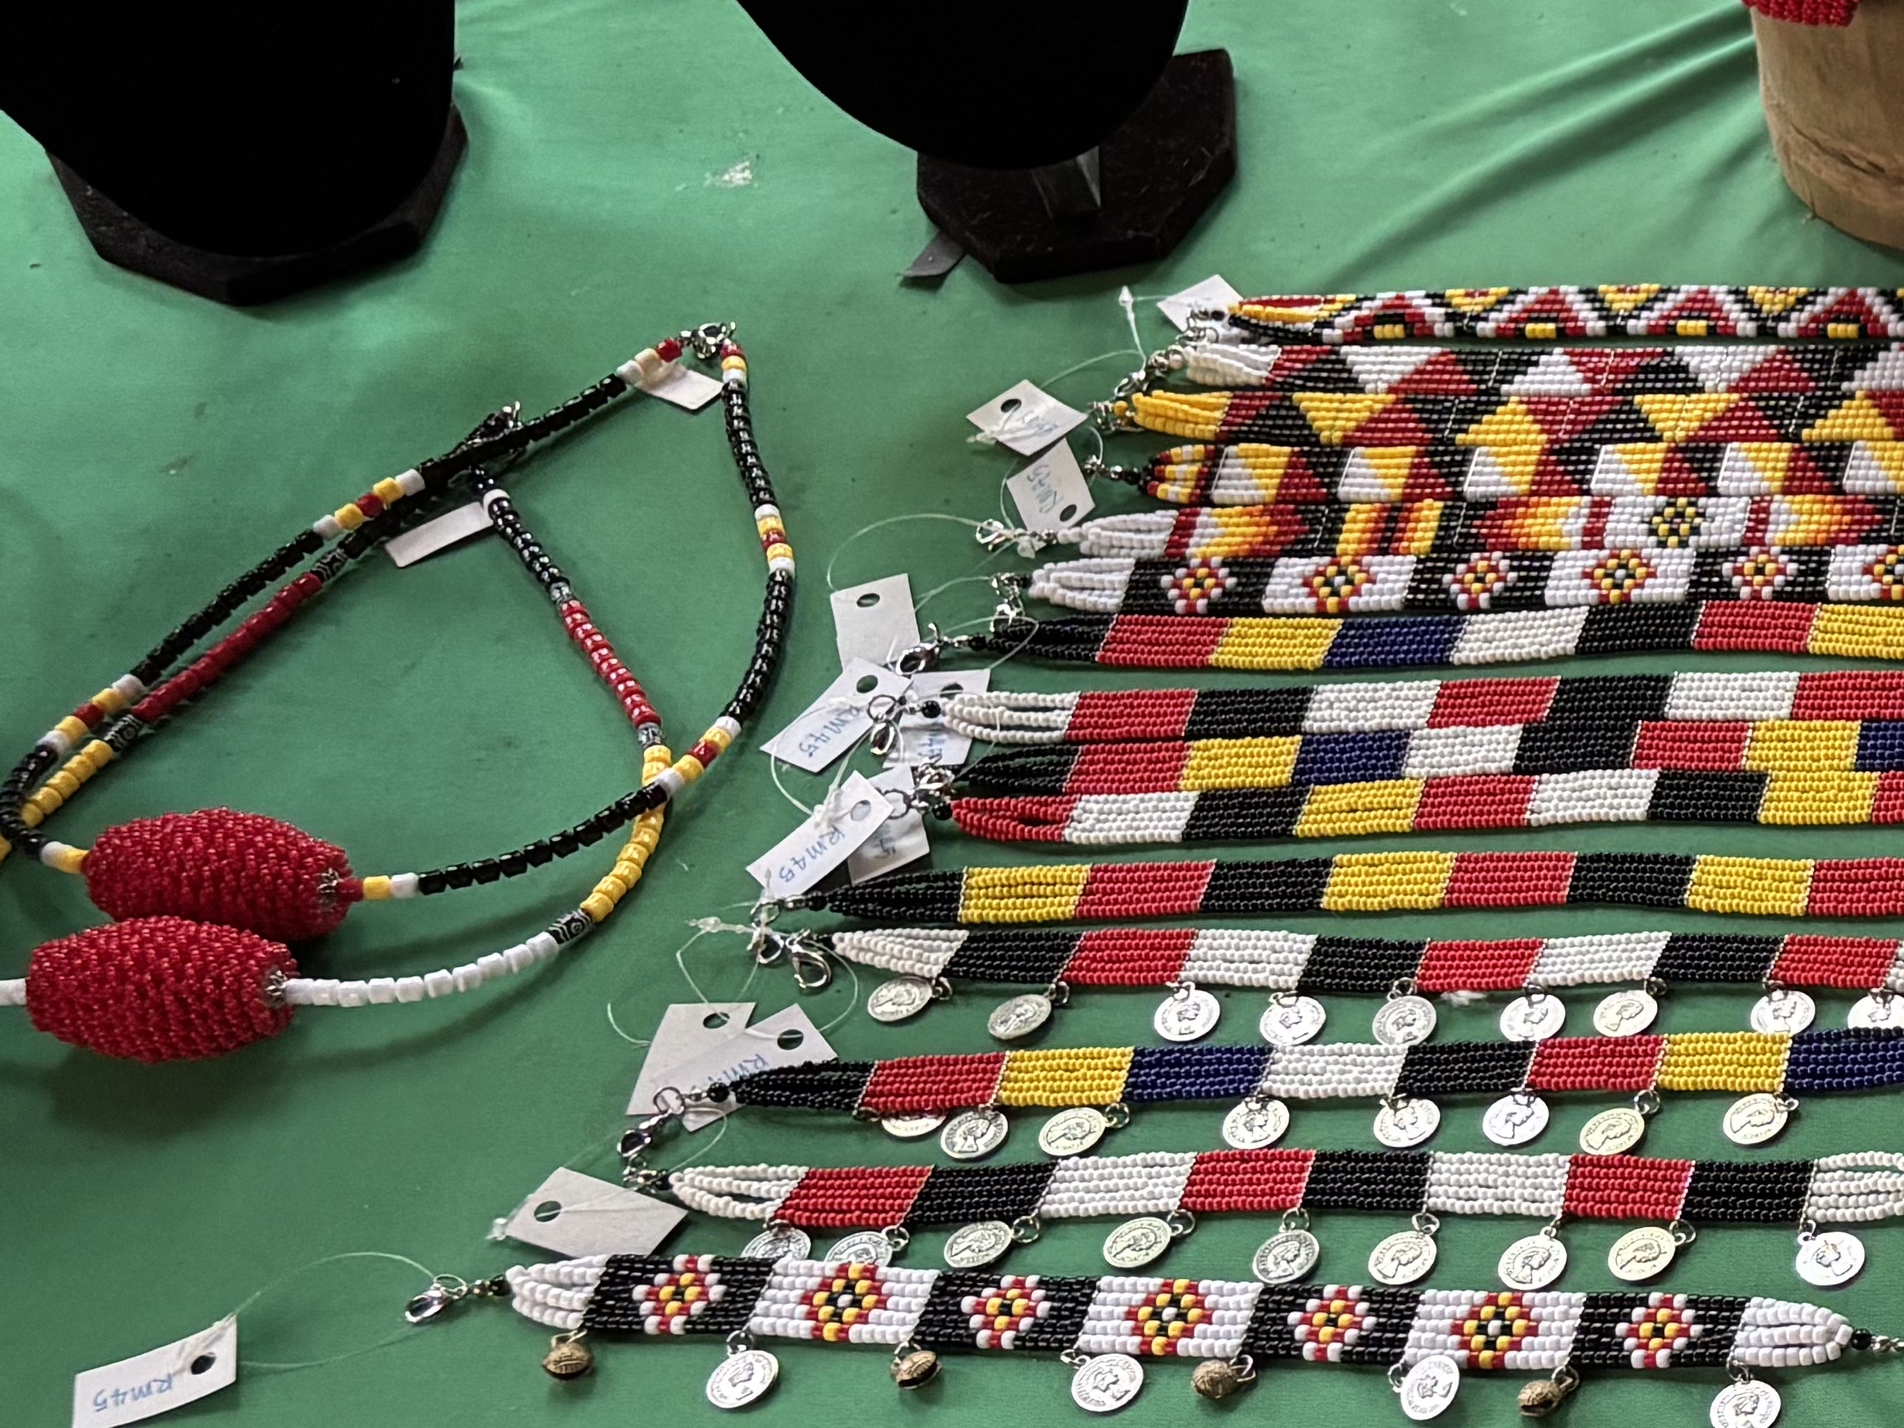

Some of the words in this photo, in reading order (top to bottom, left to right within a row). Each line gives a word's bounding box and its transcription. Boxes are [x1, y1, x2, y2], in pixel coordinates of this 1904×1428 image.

[799, 706, 860, 757] RM45
[778, 825, 845, 883] RM45
[93, 1373, 174, 1412] RM45
